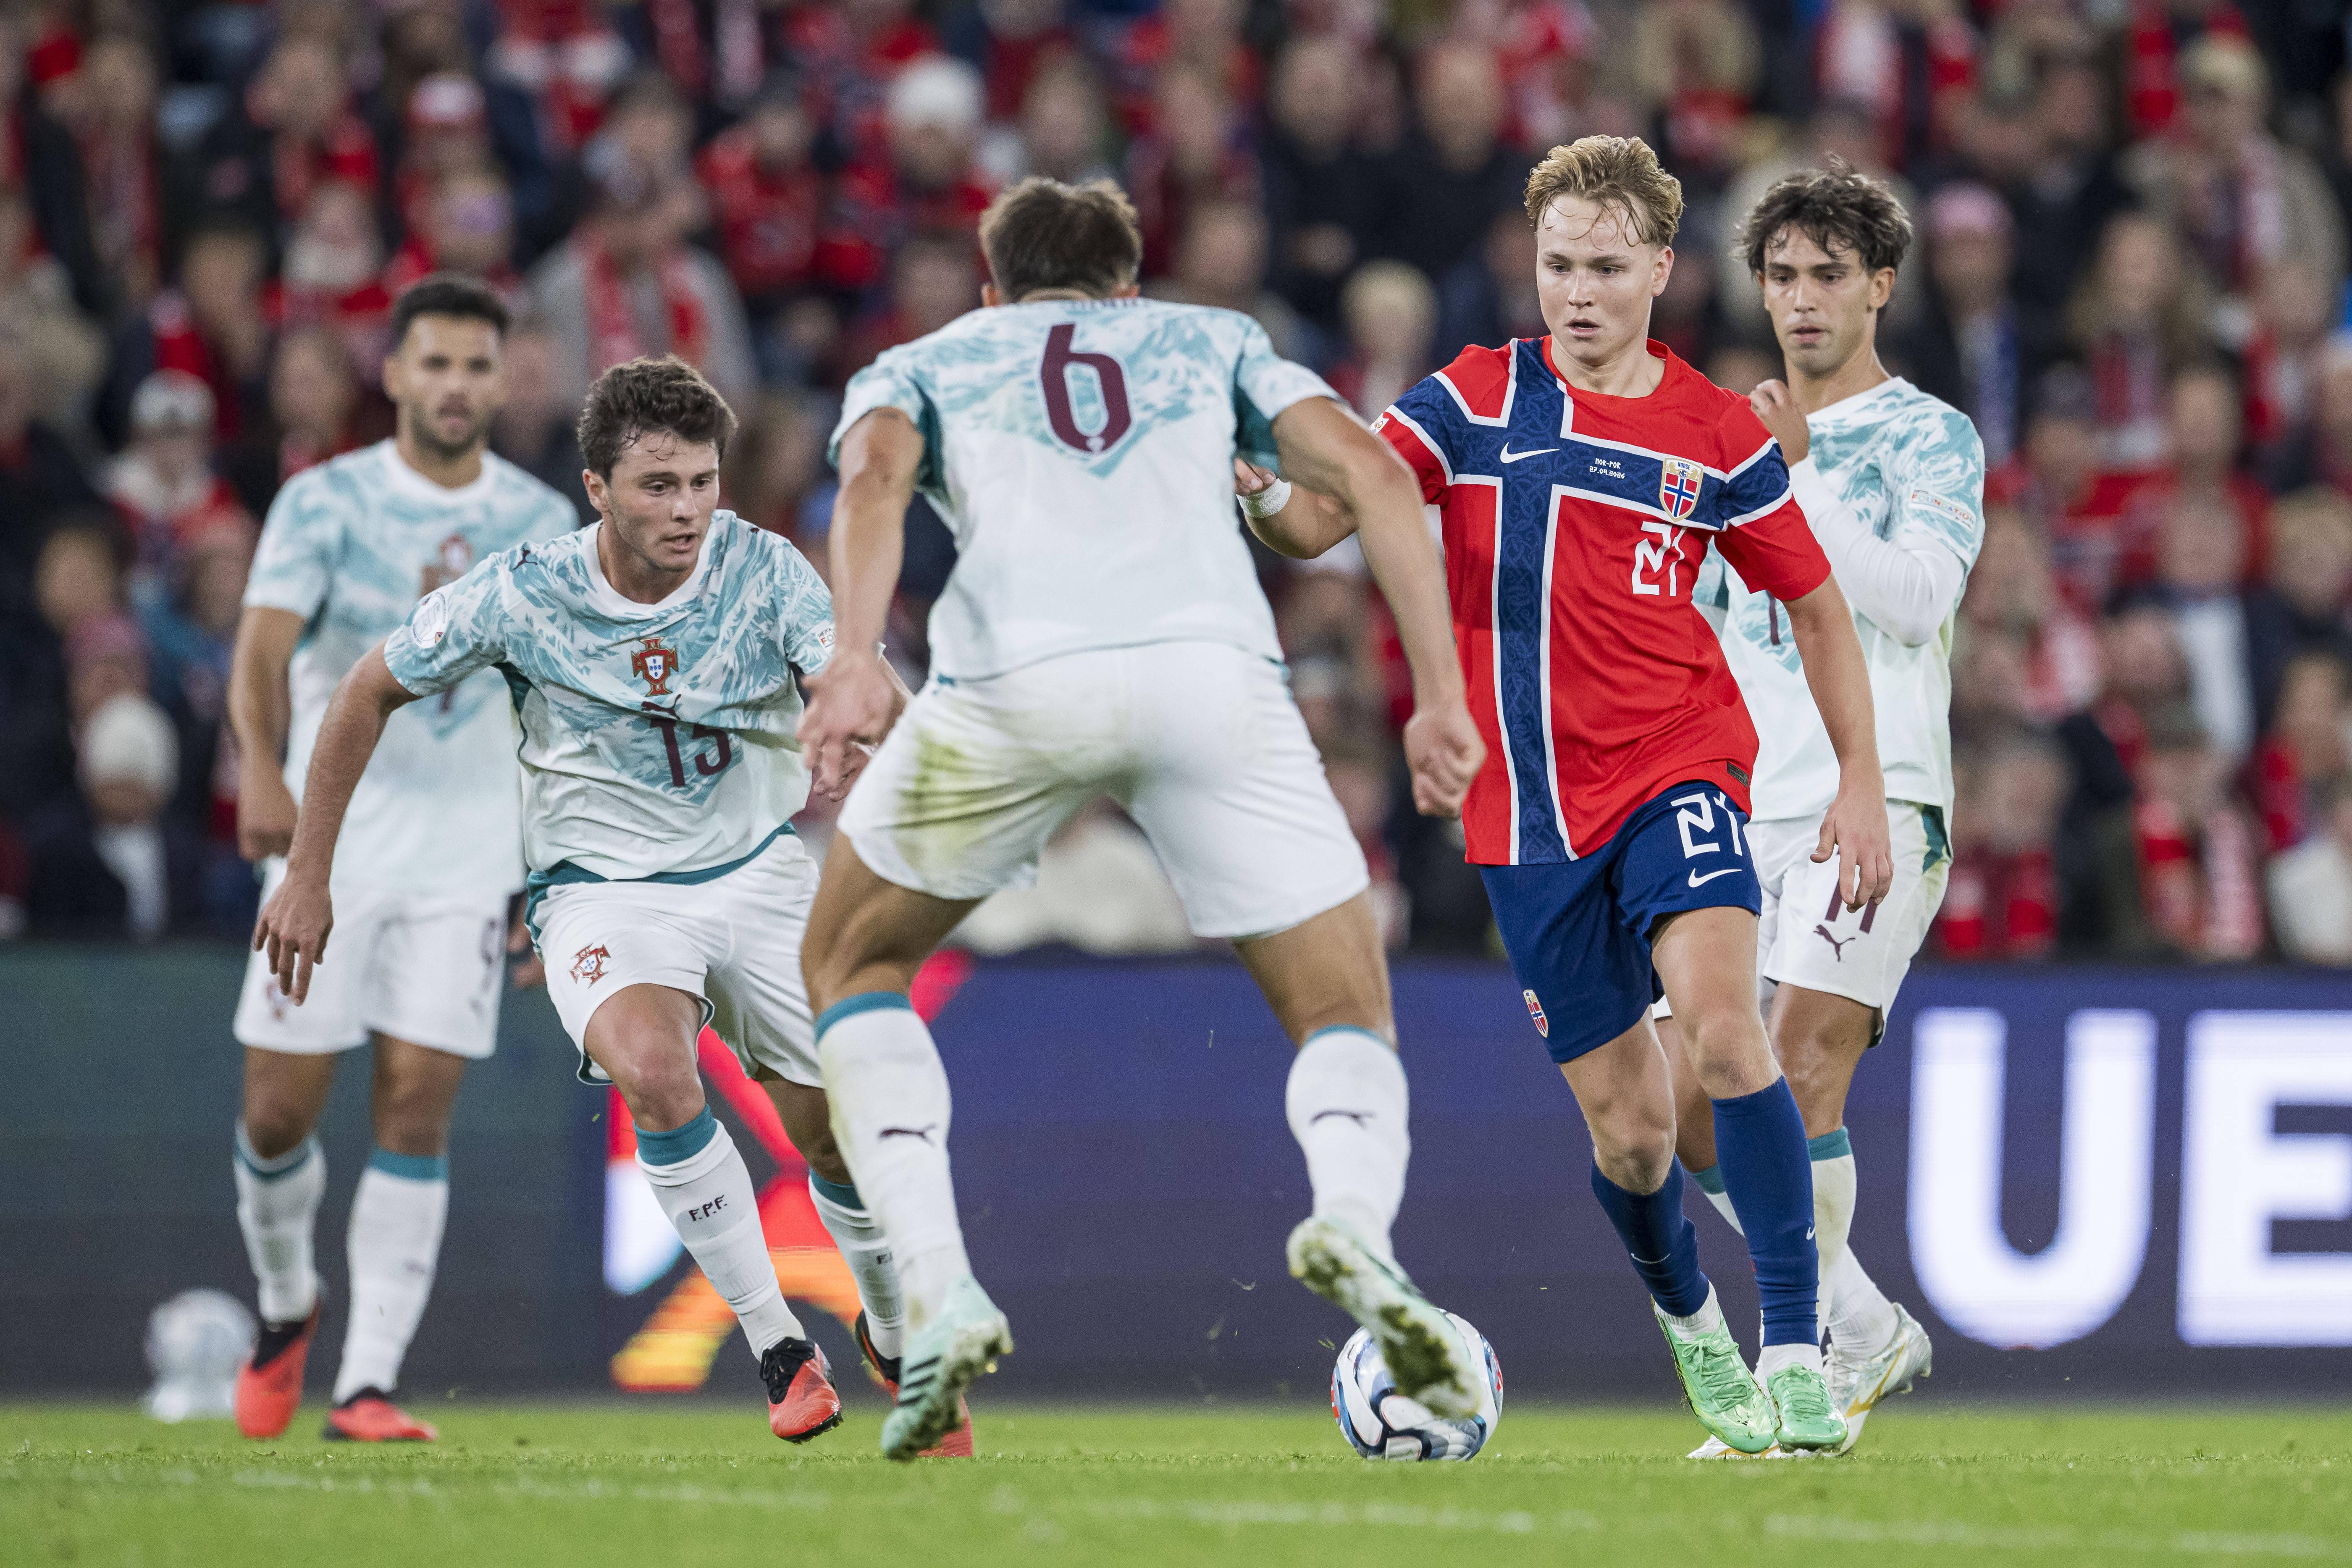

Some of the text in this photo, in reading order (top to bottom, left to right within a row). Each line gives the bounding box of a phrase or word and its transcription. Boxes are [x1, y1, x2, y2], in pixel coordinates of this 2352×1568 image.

[1039, 322, 1134, 454] 6
[1589, 465, 1625, 479] 27.09.2026
[1595, 457, 1621, 469] NOR-POR
[1677, 462, 1690, 470] NORGE
[1632, 521, 1687, 596] 21
[649, 718, 732, 787] 15
[1670, 792, 1742, 859] 21
[688, 1195, 727, 1221] F.P.F.
[1907, 1007, 2352, 1350] UE
